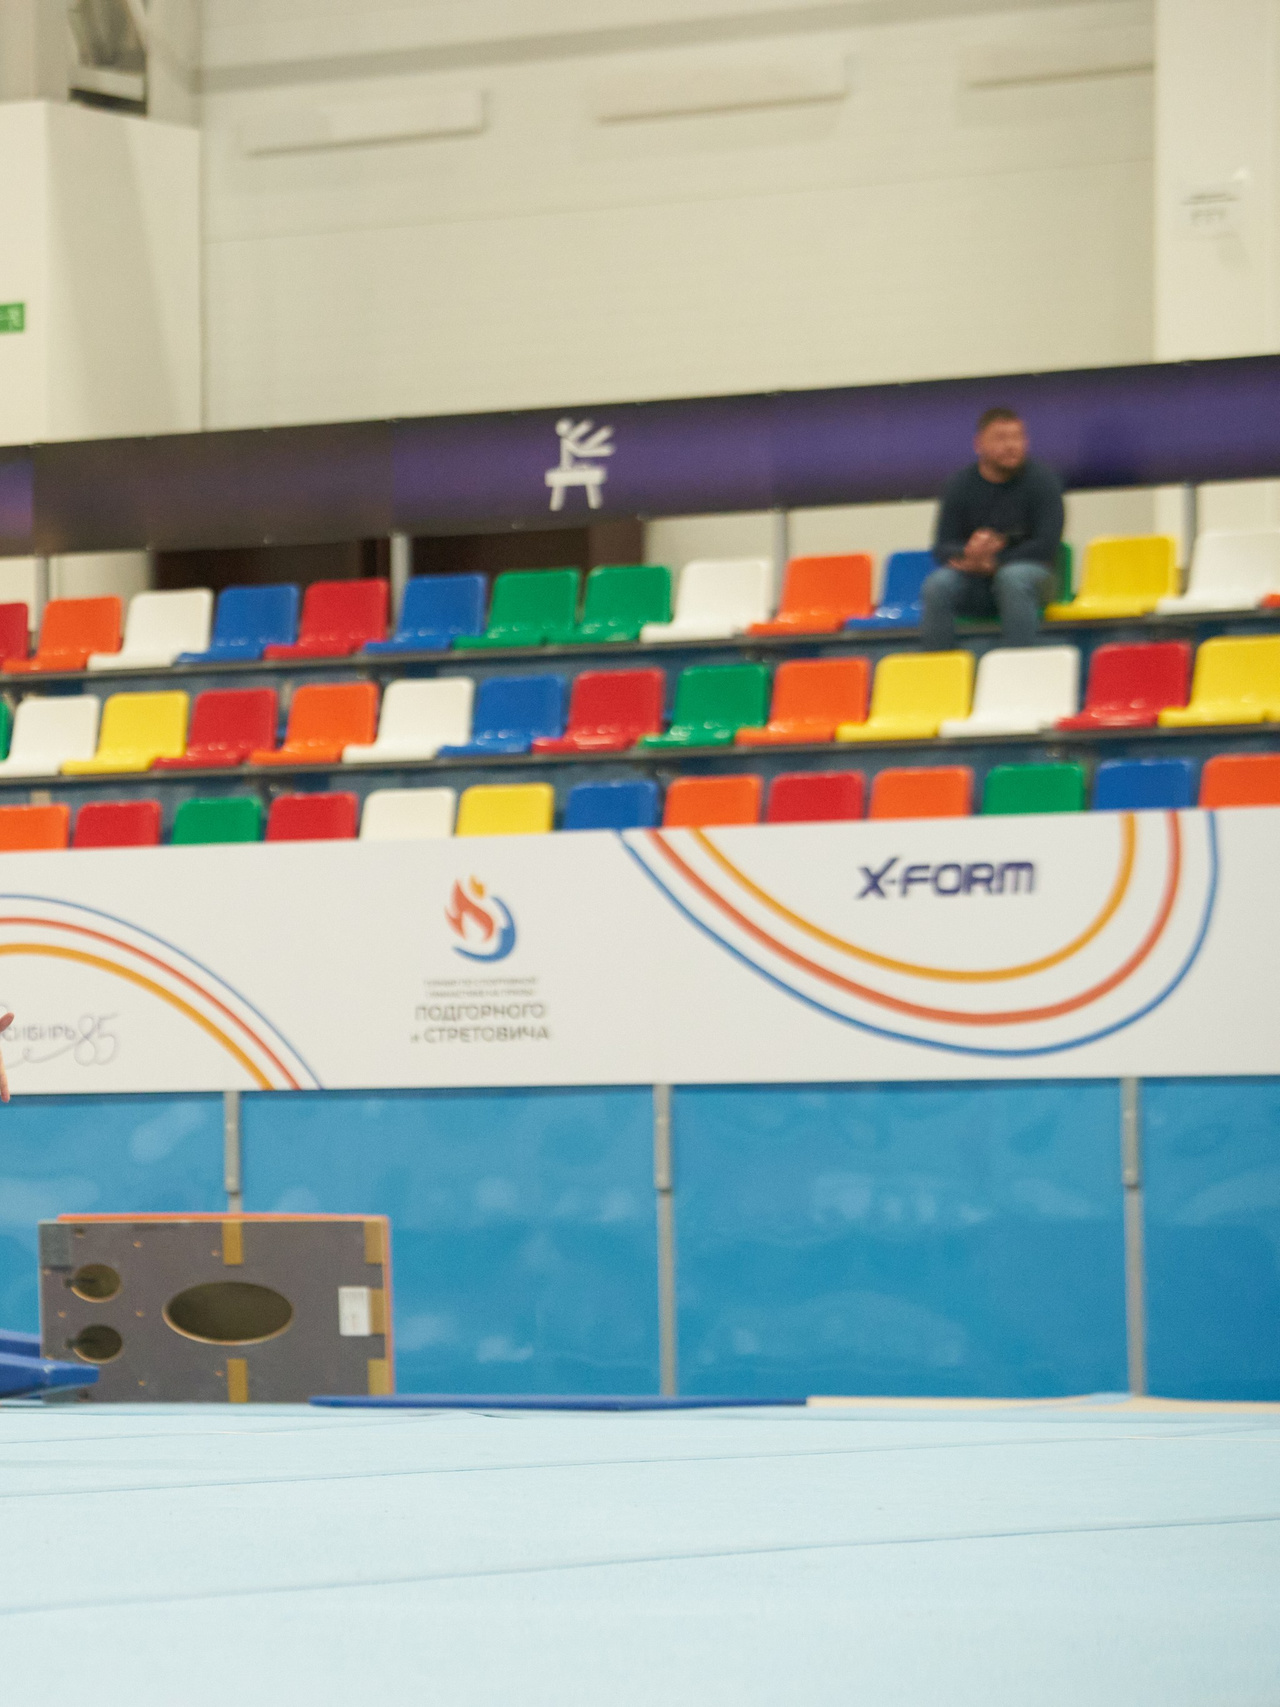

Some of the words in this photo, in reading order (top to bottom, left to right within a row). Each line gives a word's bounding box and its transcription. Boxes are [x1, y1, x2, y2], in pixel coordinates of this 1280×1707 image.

[855, 856, 1034, 899] X-FORM
[414, 1003, 546, 1021] ПОДГОРНОГО
[423, 1026, 550, 1043] СТРЕТОВИЧА
